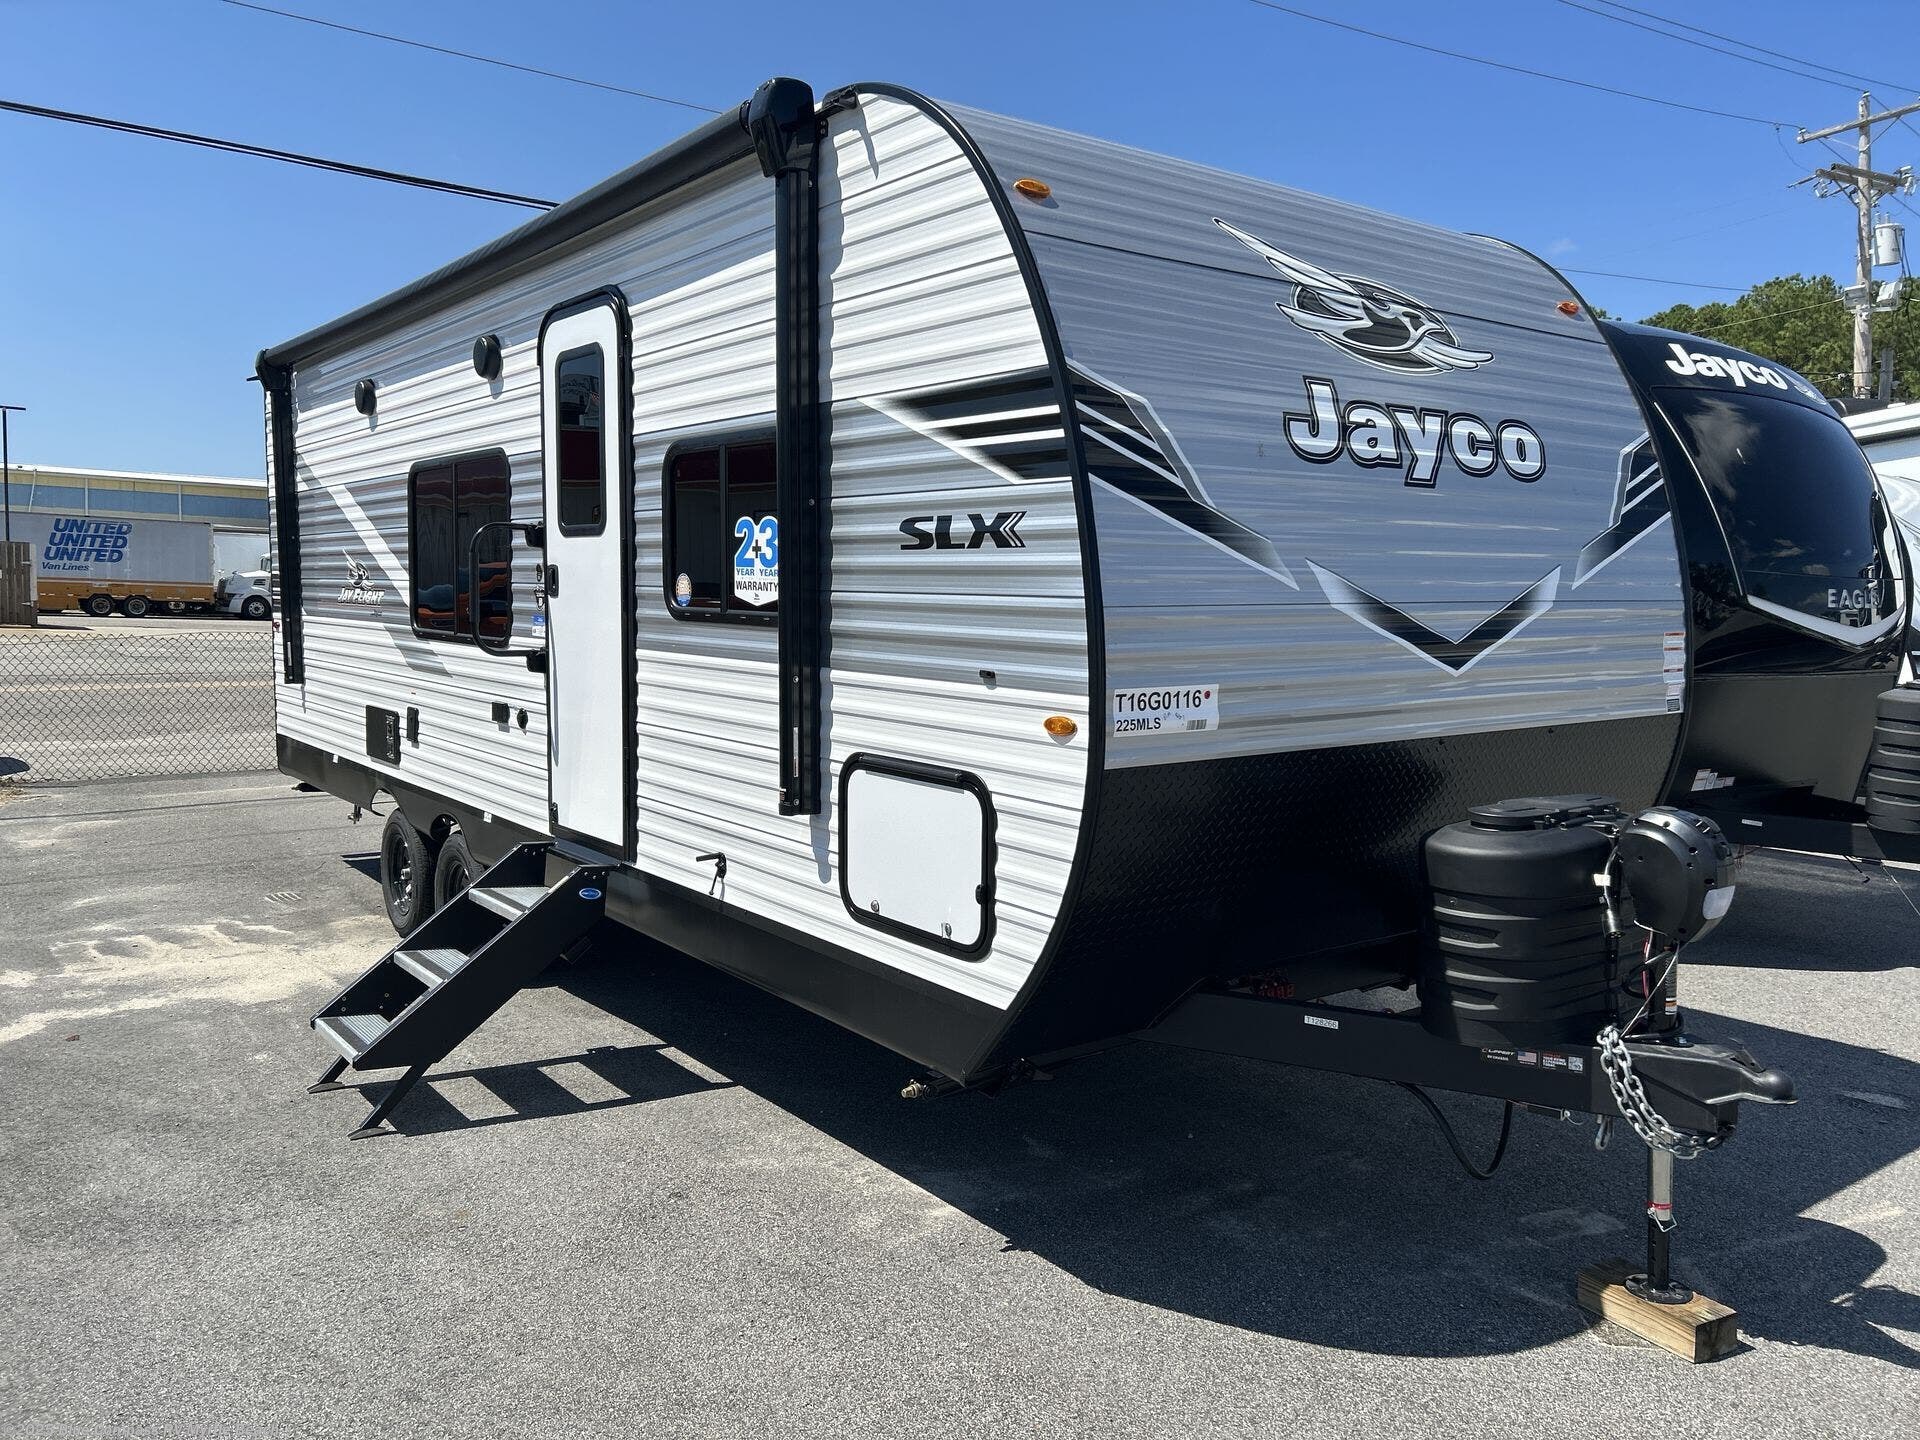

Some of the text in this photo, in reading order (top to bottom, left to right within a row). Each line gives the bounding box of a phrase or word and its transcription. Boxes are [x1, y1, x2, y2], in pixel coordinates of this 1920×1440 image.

[1665, 343, 1789, 391] Jayco
[1283, 375, 1546, 488] Jayco
[54, 518, 133, 535] UNITED
[899, 511, 1027, 550] SLX
[49, 532, 128, 549] UNITED
[44, 546, 123, 563] UNITED
[42, 562, 90, 571] Van Lines
[736, 567, 755, 576] YEAR
[736, 580, 778, 592] WARRANTY
[1115, 689, 1202, 713] T16G0116
[1116, 717, 1161, 732] 225MLS
